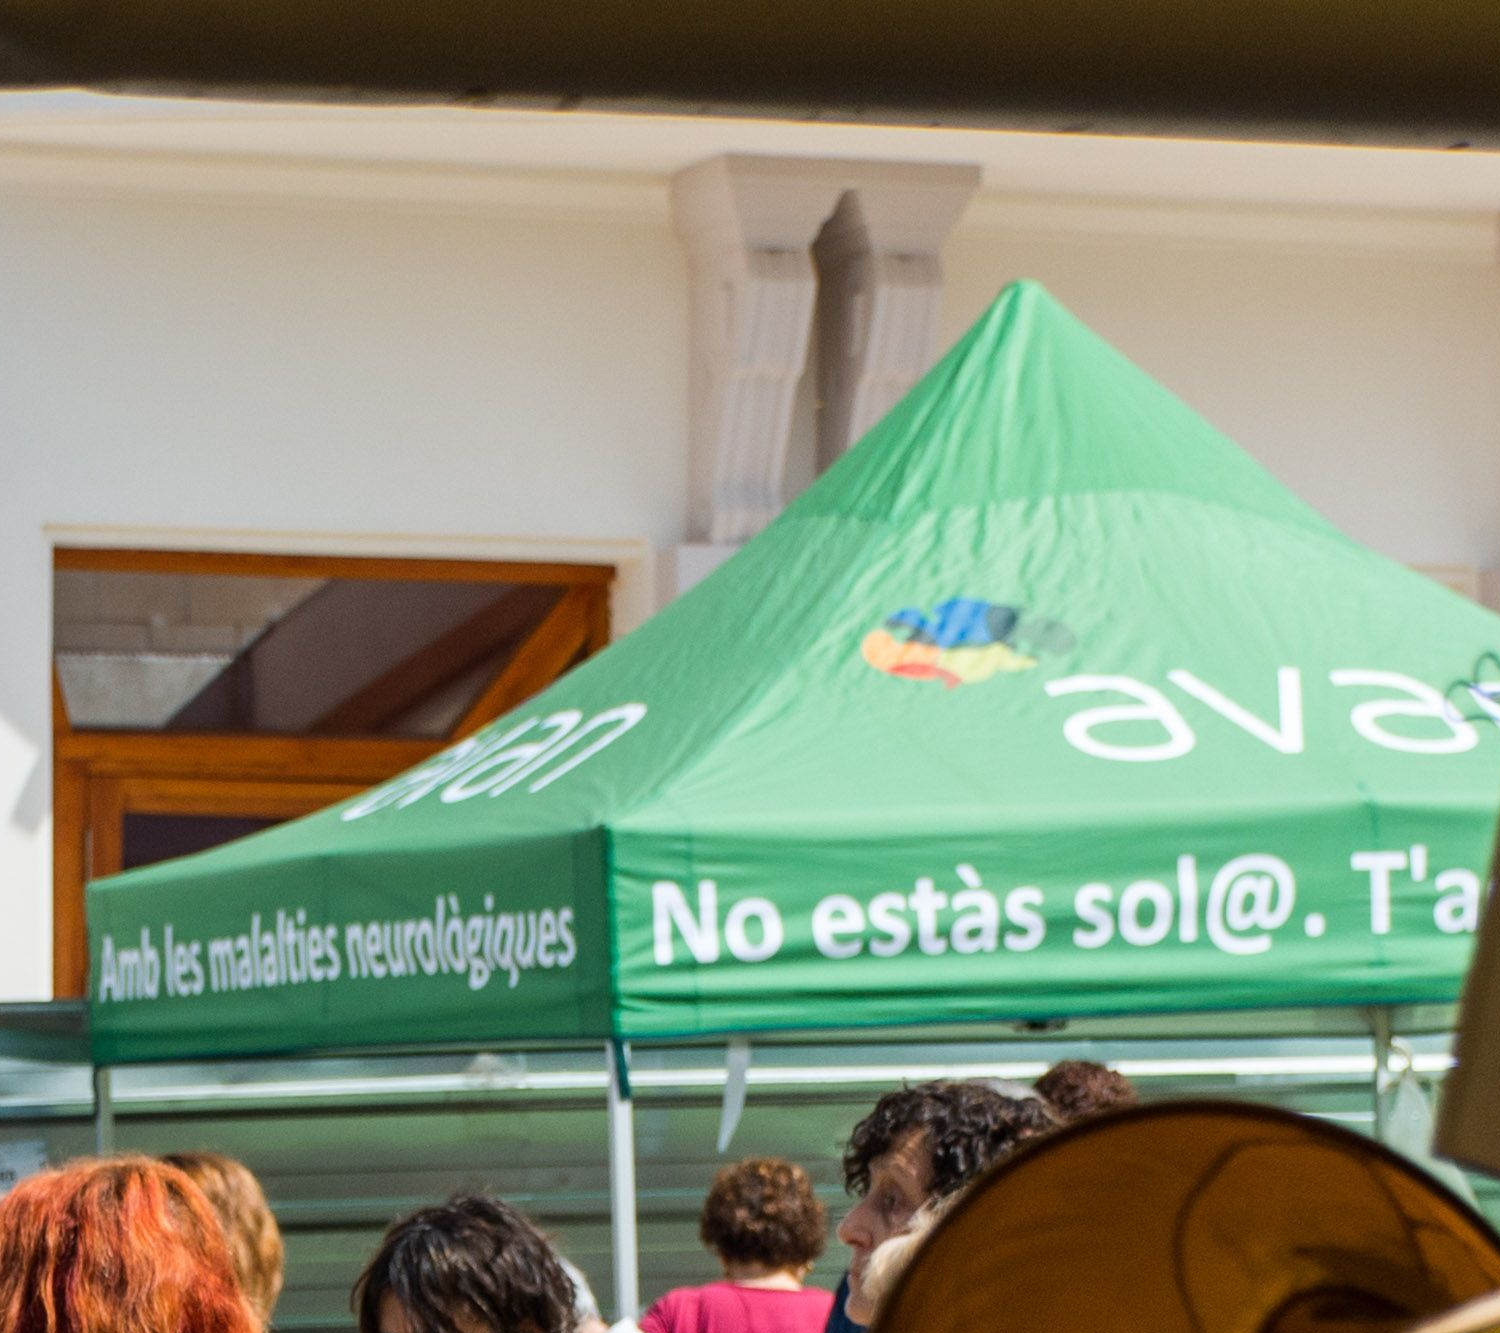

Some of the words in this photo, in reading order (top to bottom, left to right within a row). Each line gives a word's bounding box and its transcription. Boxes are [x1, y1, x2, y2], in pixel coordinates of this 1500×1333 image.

[98, 925, 160, 1004] Amb
[163, 923, 205, 997] les
[208, 908, 342, 993] malalties
[344, 892, 577, 991] neurològiques
[651, 878, 784, 966] No
[810, 863, 1047, 959] estàs
[1071, 853, 1327, 956] sol@.
[1349, 843, 1483, 936] T'a
